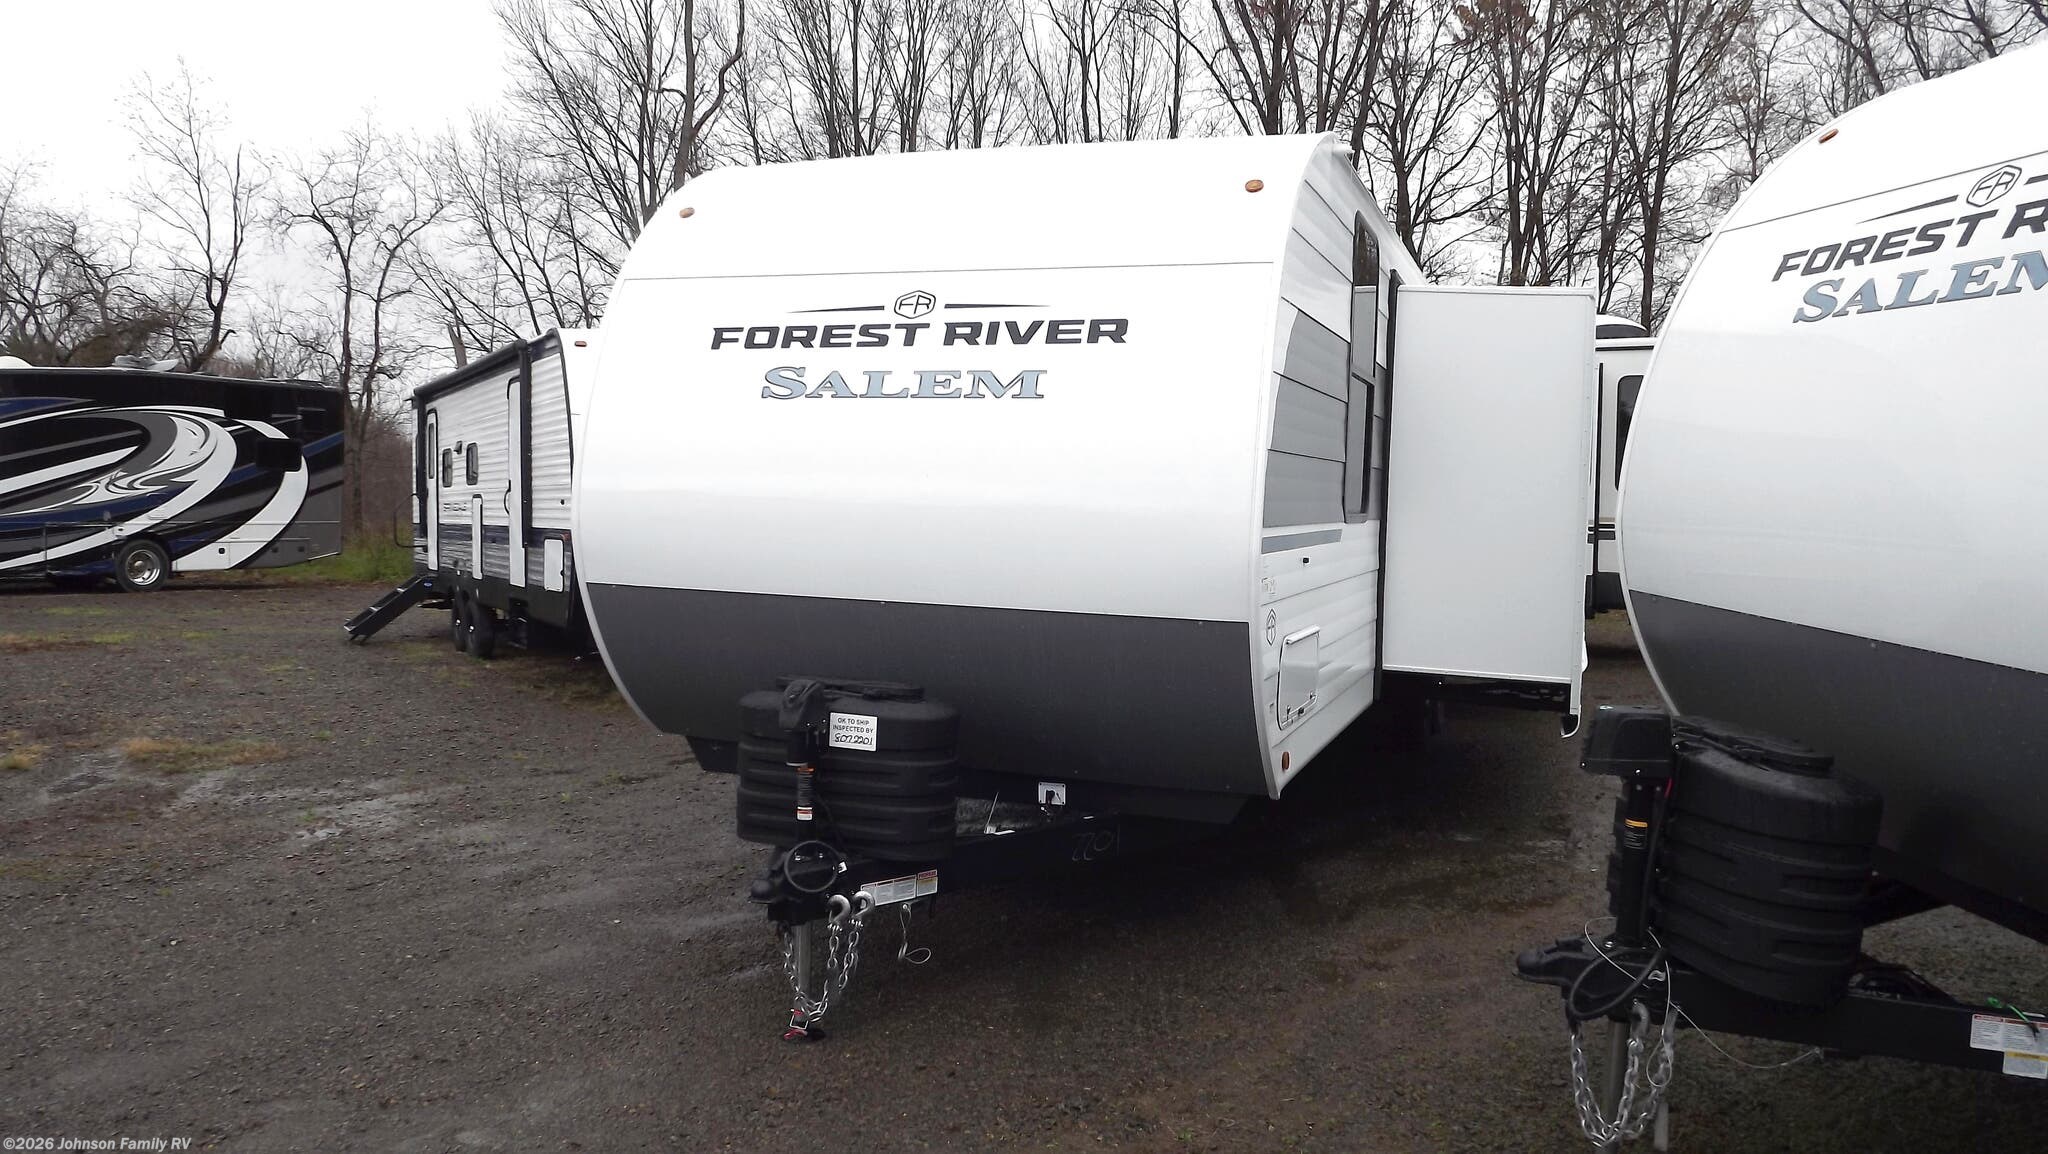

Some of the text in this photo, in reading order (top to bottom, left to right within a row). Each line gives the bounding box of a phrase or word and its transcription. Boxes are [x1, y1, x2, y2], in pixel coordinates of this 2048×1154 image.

[1771, 209, 1999, 282] FOREST
[897, 294, 934, 316] FR
[711, 318, 1129, 350] FOREST RIVER
[761, 366, 1048, 401] SALEM
[832, 724, 864, 733] INSPECTED
